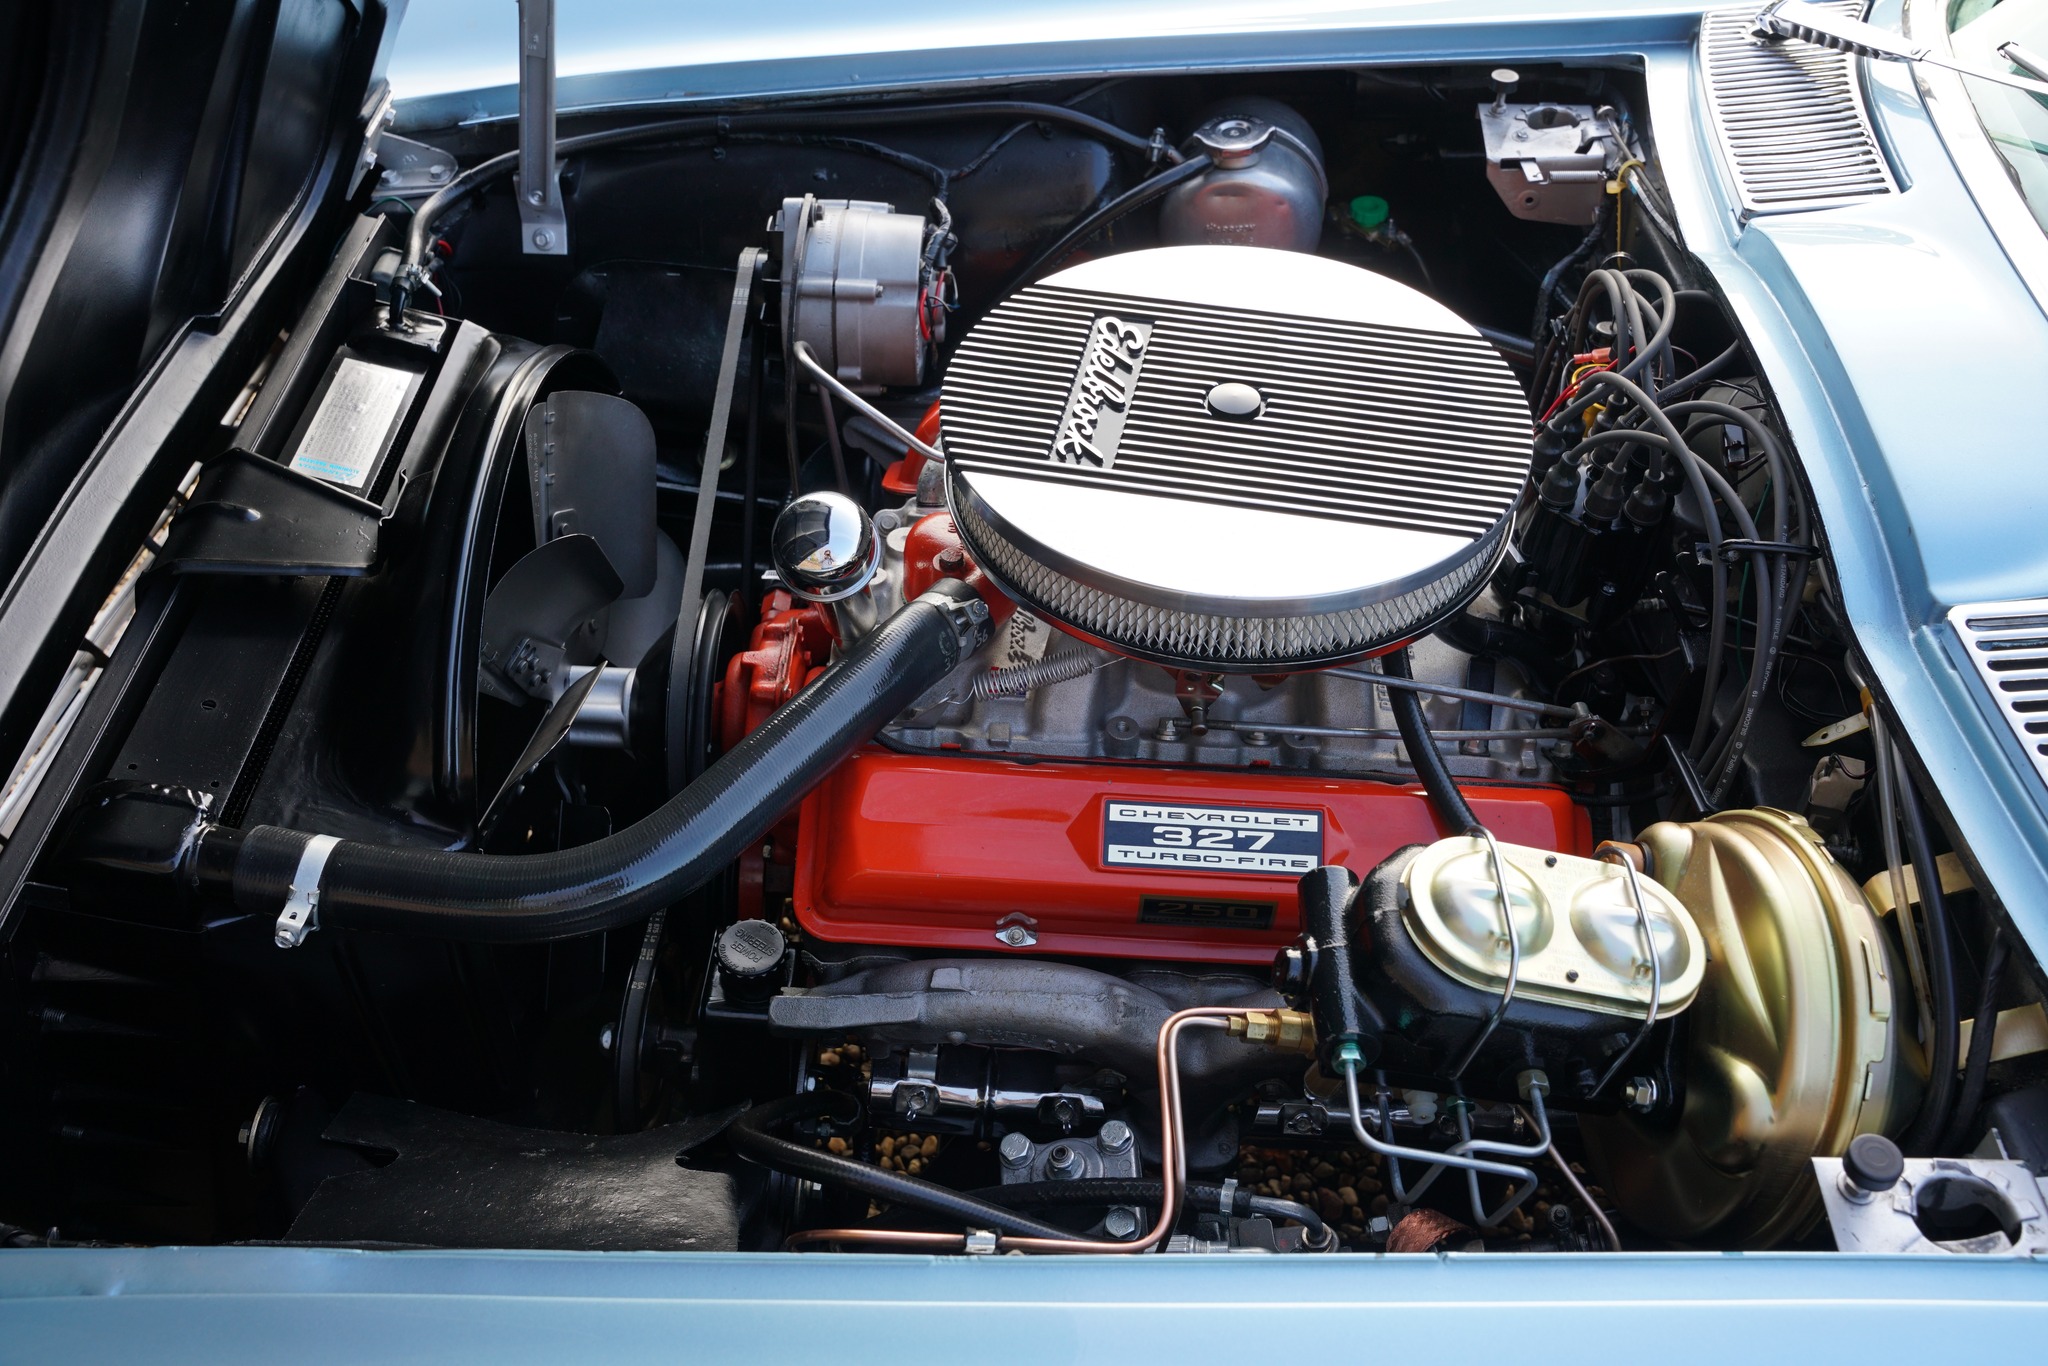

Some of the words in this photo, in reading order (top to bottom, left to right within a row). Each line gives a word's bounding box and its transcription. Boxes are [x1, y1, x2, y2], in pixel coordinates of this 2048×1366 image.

[1056, 316, 1144, 464] Edelbrock
[1778, 564, 1787, 599] STANDARD
[1772, 617, 1782, 640] TRIPLE
[1726, 754, 1738, 774] TRIPLE
[1740, 707, 1755, 737] SILICONE
[1119, 808, 1310, 827] CHEVROLET
[1151, 825, 1276, 851] 327
[1117, 849, 1310, 869] TURBO-FIRE
[1157, 902, 1258, 919] 250
[759, 923, 777, 936] FLUID
[730, 941, 762, 963] POWER
[735, 928, 776, 957] STEERING
[719, 943, 739, 970] APPROVED
